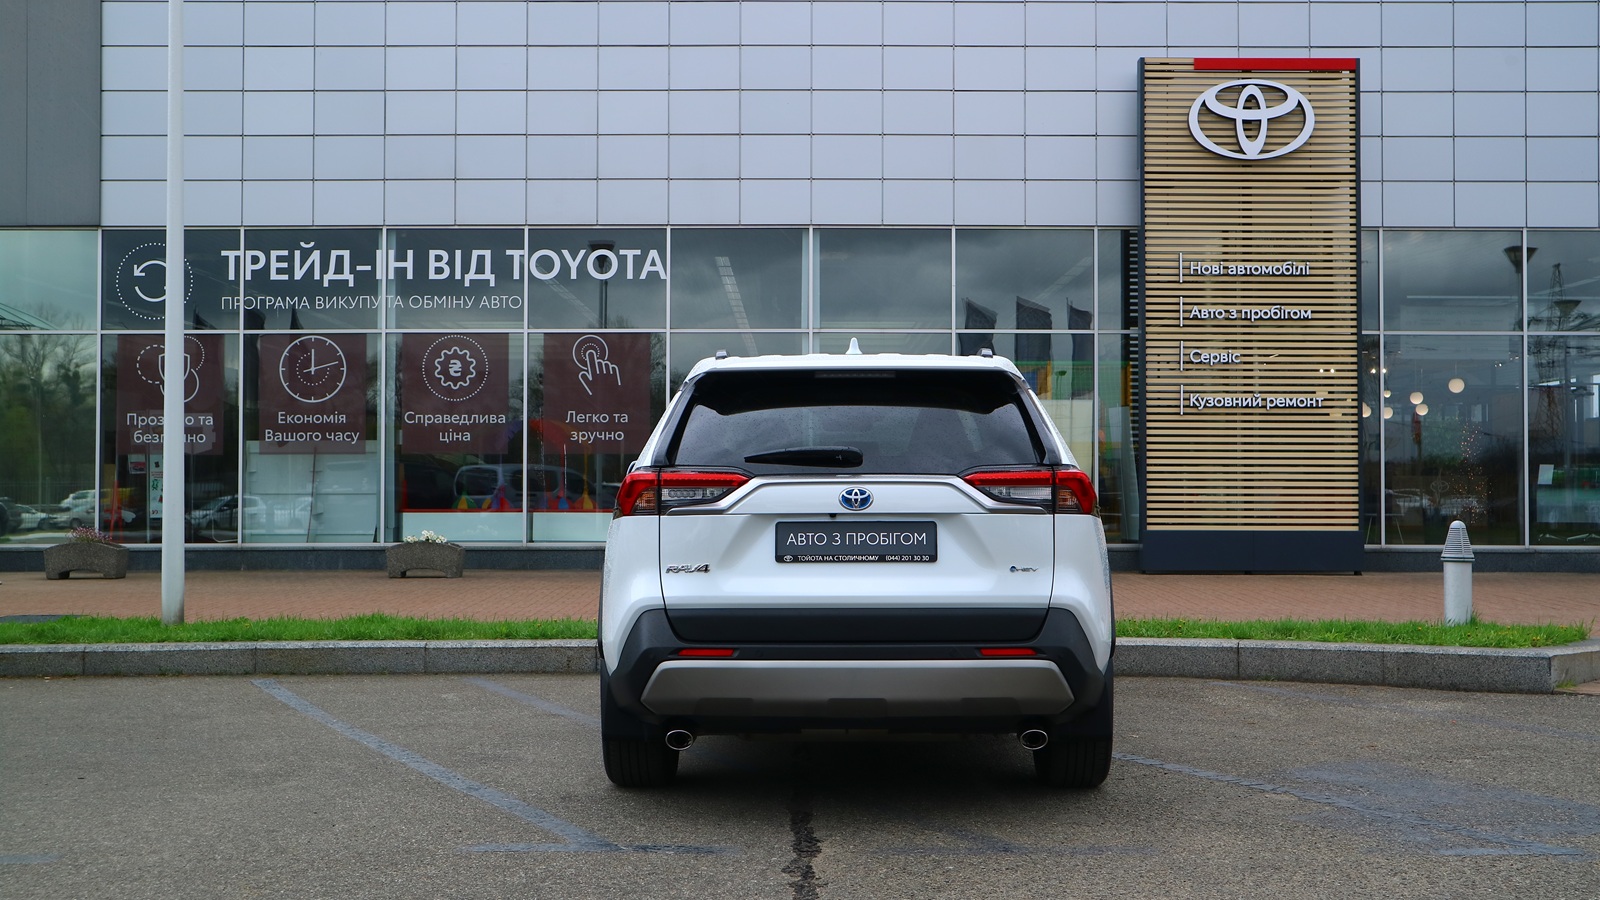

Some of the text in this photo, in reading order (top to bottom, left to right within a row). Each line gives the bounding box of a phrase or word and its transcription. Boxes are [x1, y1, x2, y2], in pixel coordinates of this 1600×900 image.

[220, 241, 668, 287] ТРЕЙД-ІН ВІД TOYOTA
[1189, 261, 1311, 276] Нові автомобілі
[221, 295, 522, 310] ПРОГРАМА ВИКУПУ ТА ОБМІНУ АВТО
[1189, 305, 1312, 322] Авто з пробігом
[1189, 350, 1241, 366] Сервіс
[1189, 393, 1324, 410] Кузовний ремонт
[126, 413, 214, 428] Прозо та
[277, 411, 347, 424] Економія
[404, 411, 506, 427] Справедлива
[565, 410, 629, 423] Легко та
[133, 430, 207, 443] безно
[264, 429, 360, 445] Вашого часу
[439, 428, 471, 443] ціна
[570, 430, 625, 444] зручно
[786, 532, 927, 546] АВТО З ПРОБІГОМ
[797, 554, 823, 562] ТОЙОТА
[834, 554, 880, 562] СТОЛИЧНОМУ
[885, 554, 900, 562] (044)
[901, 554, 912, 562] 201
[913, 554, 921, 562] 30
[922, 554, 930, 562] 30
[665, 562, 711, 574] RAV4
